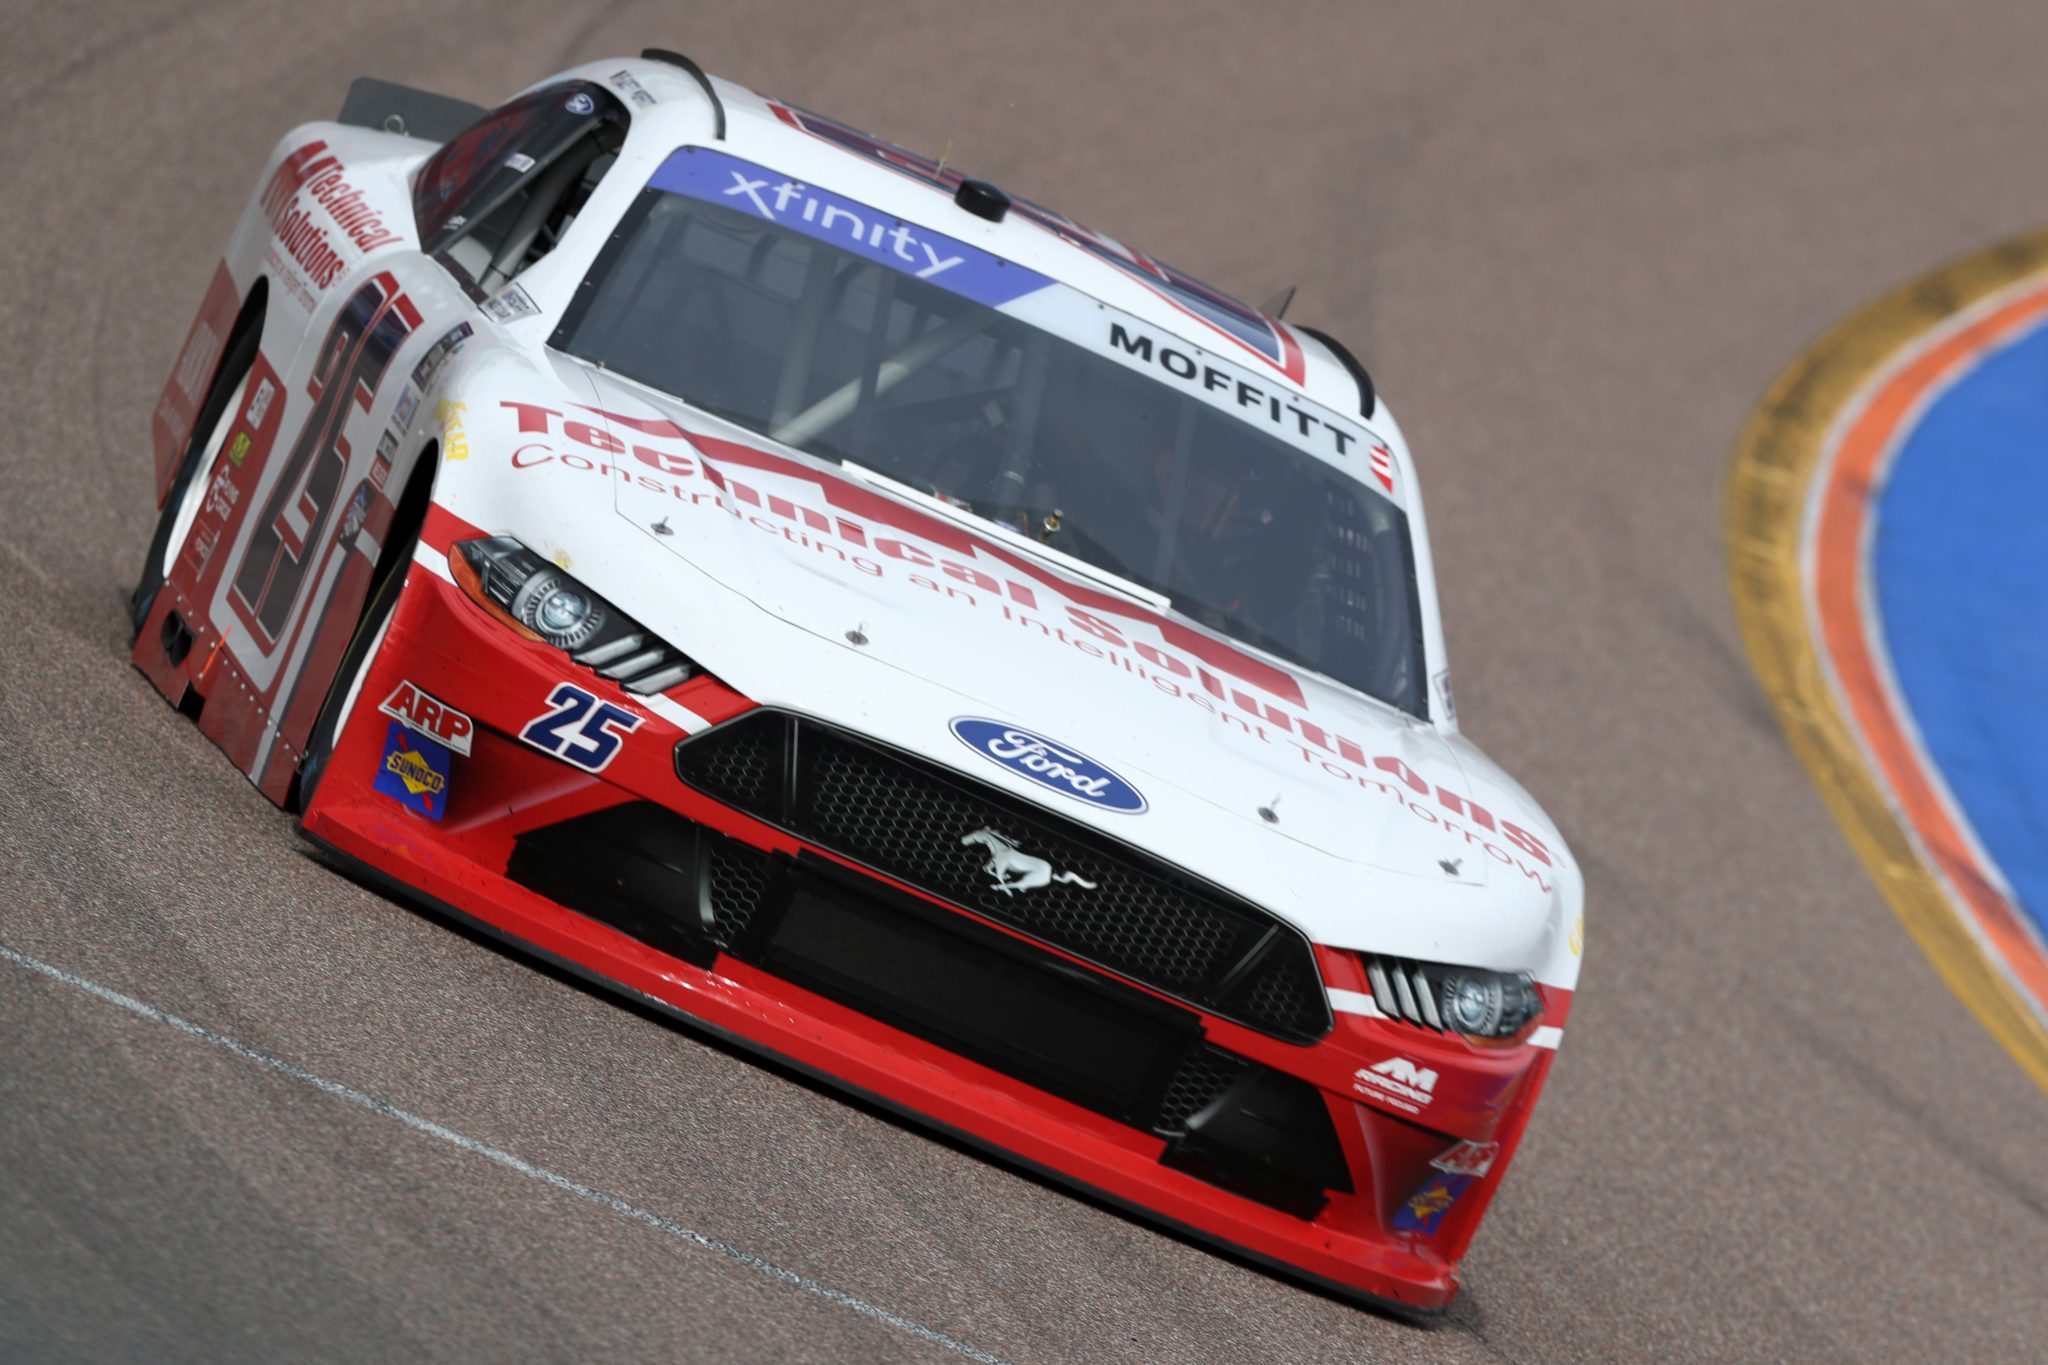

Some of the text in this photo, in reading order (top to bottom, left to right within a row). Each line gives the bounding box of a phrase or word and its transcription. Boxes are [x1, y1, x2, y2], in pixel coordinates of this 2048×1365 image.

[306, 164, 404, 253] Technical
[722, 170, 965, 279] xfinity
[1110, 323, 1357, 456] MOFFITT
[500, 401, 1038, 610] Technical
[511, 443, 883, 577] Constructing
[908, 573, 976, 607] an
[1003, 605, 1271, 744] Intelligent
[1287, 738, 1552, 893] Tomorrow
[386, 685, 471, 742] ARP
[518, 681, 647, 773] 25
[389, 753, 443, 792] SUNOCO
[988, 730, 1111, 797] Ford
[1368, 1057, 1438, 1093] AM
